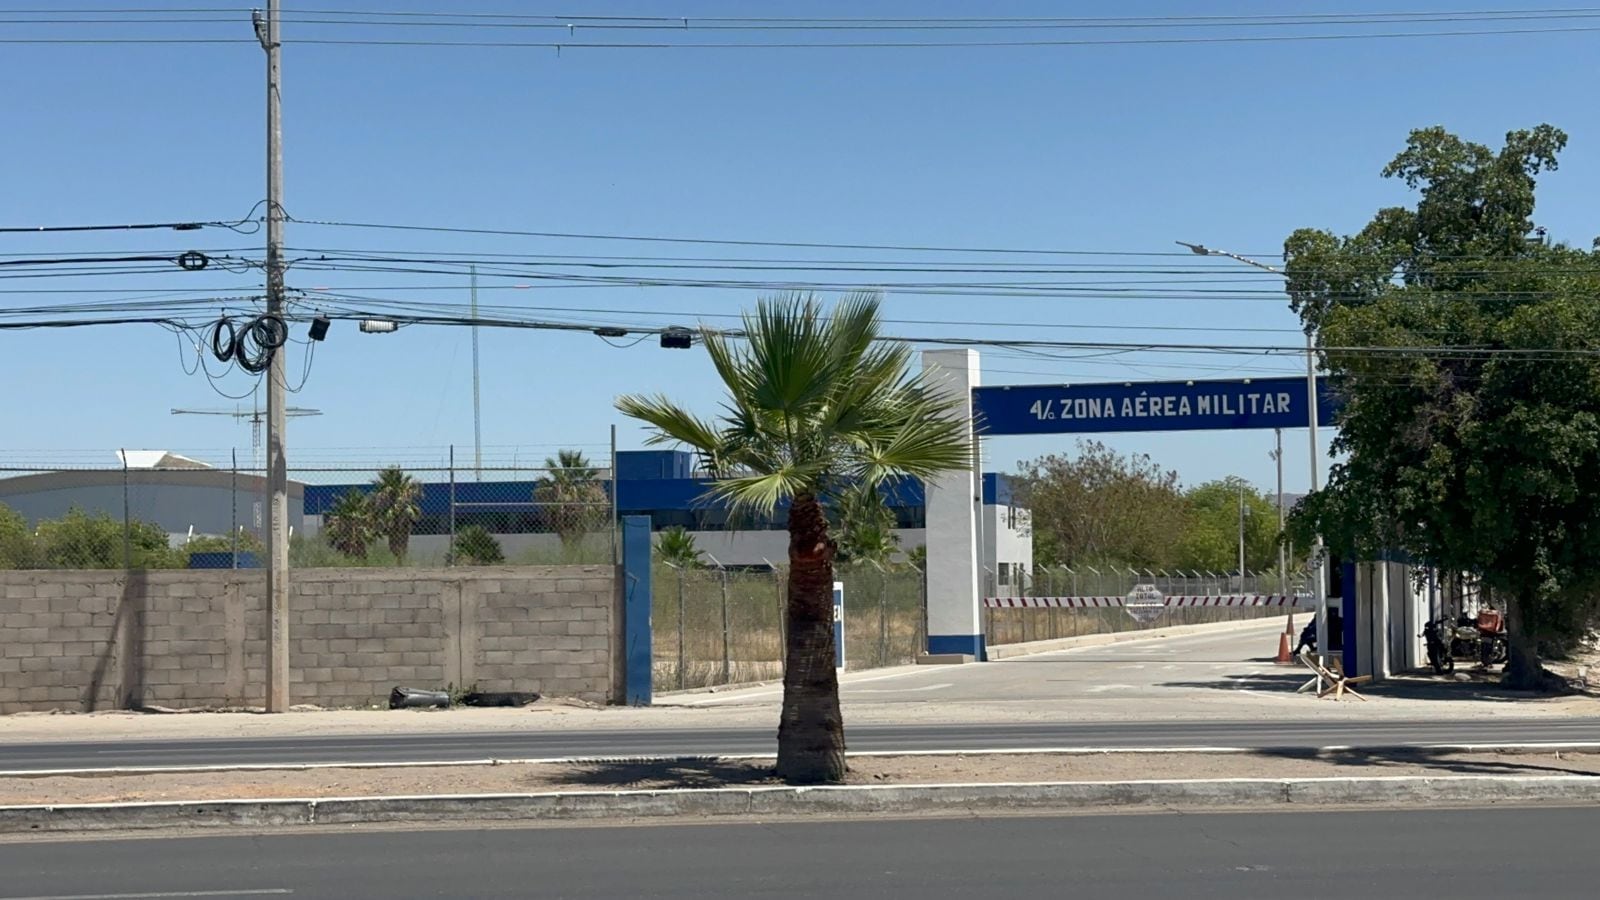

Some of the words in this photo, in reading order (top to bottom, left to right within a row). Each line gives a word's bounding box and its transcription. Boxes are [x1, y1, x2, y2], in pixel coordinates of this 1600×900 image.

[1060, 398, 1116, 419] ZONA
[1121, 390, 1192, 417] AÉREA
[1197, 392, 1291, 416] MILITAR
